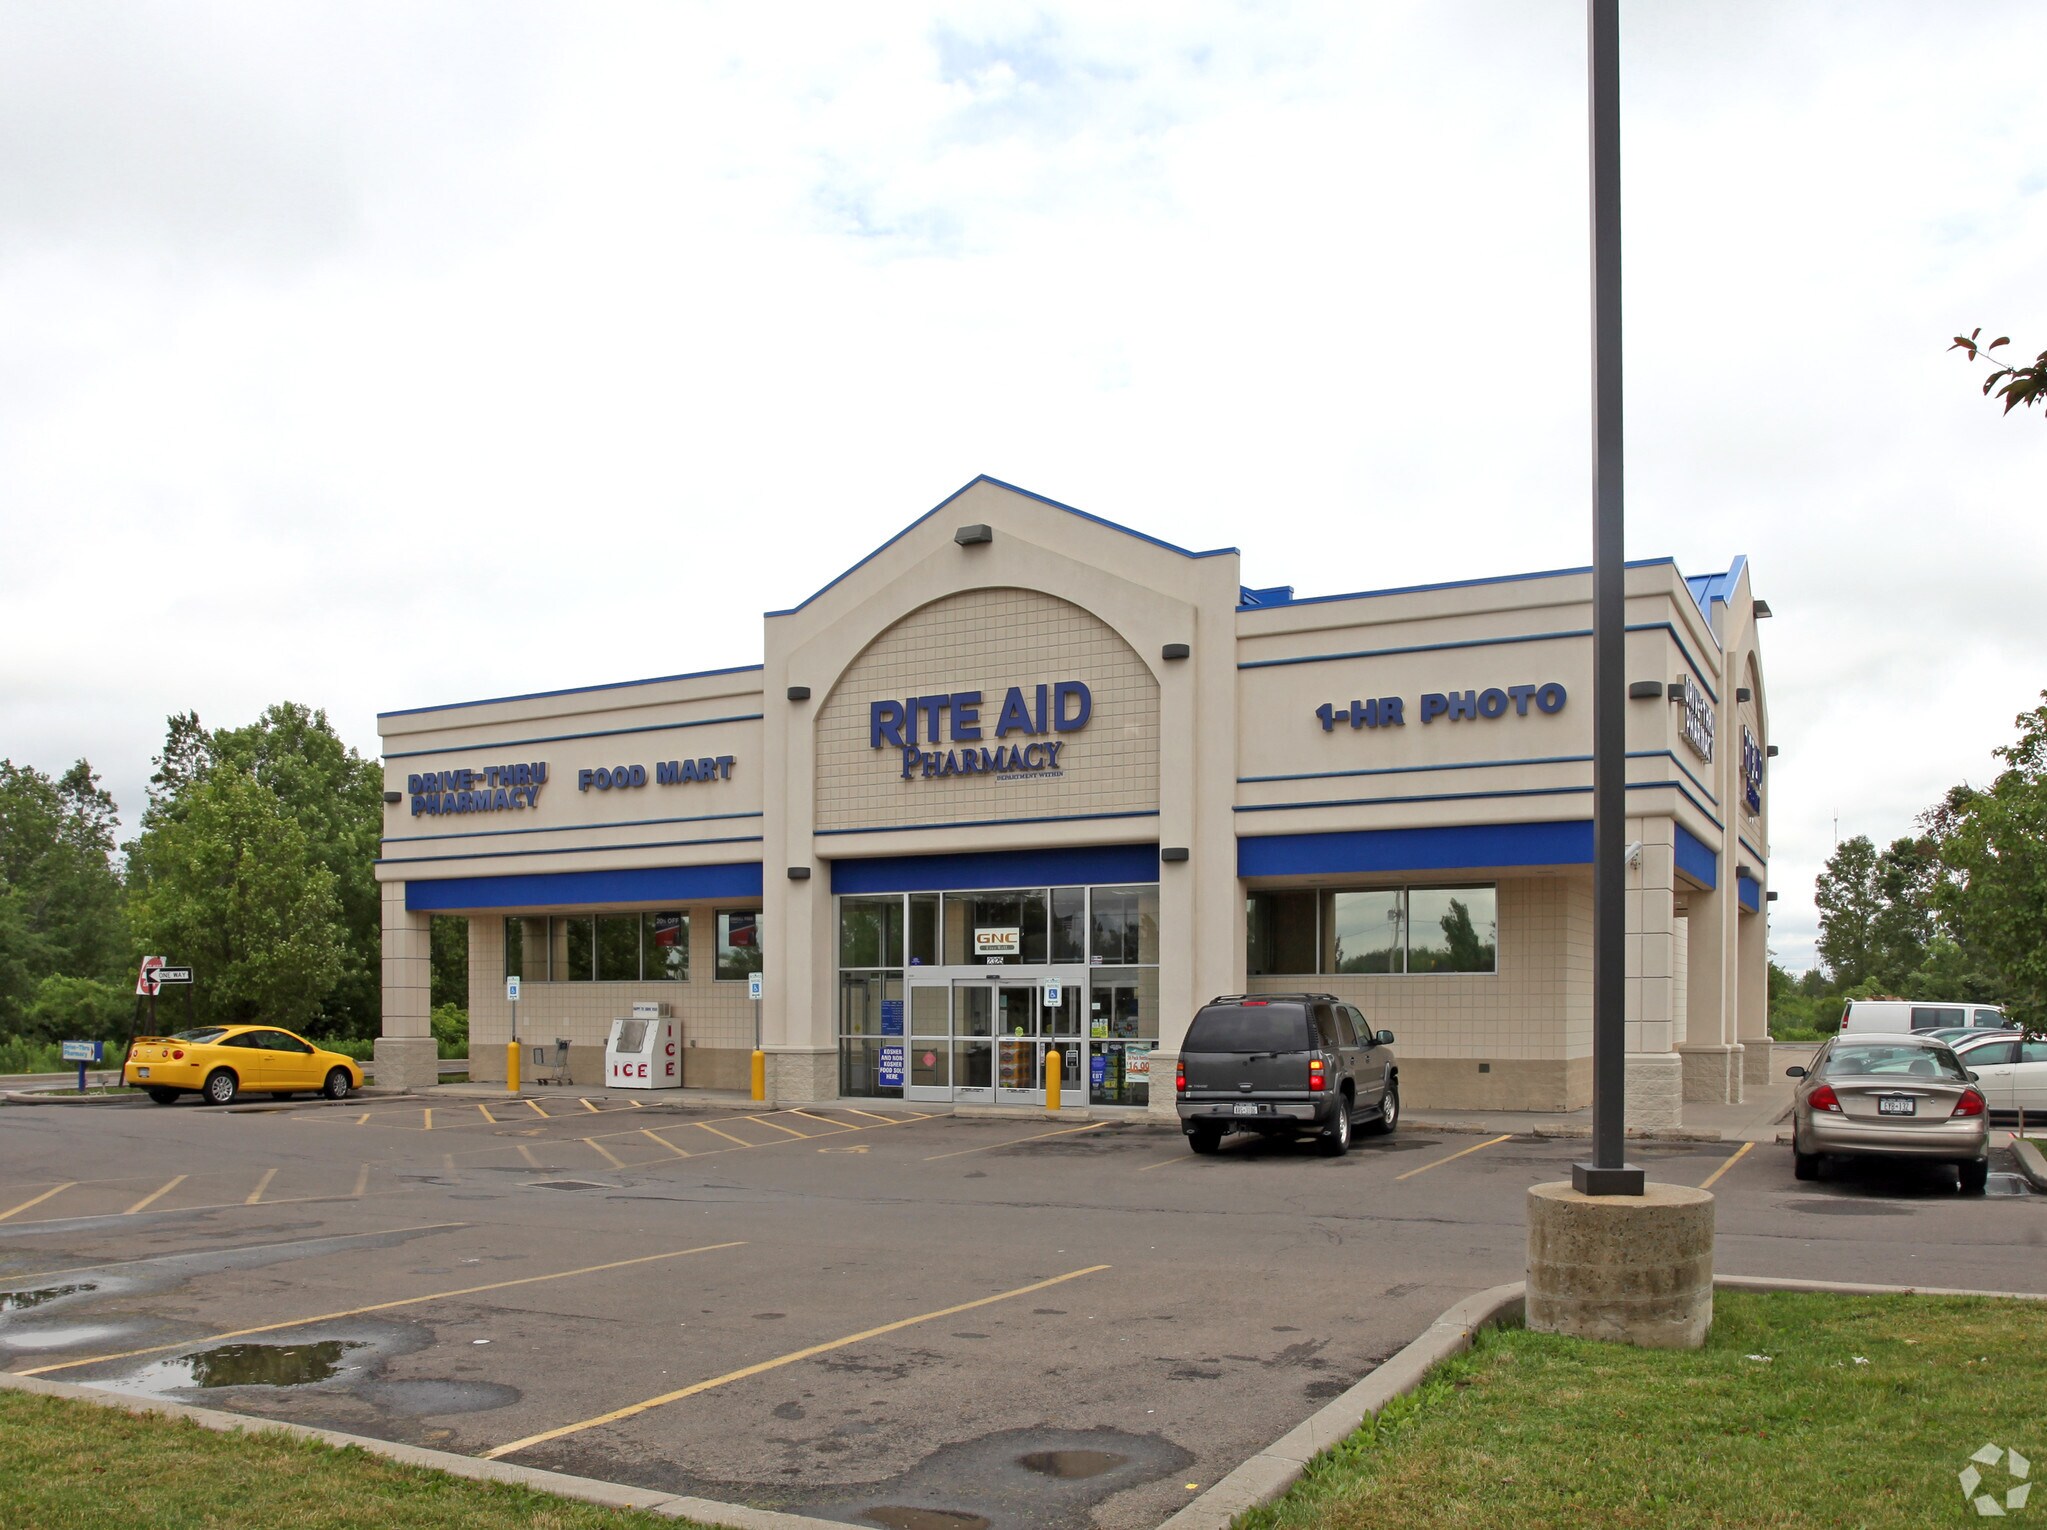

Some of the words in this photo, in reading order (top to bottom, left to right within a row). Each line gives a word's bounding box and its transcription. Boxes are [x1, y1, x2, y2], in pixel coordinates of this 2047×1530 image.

[870, 690, 983, 748] RITE
[995, 680, 1092, 737] AID
[1315, 696, 1405, 732] 1-HR
[1420, 682, 1568, 723] PHOTO
[407, 761, 549, 795] DRIVE-THRU
[578, 764, 647, 792] FOOD
[656, 755, 736, 785] MART
[900, 741, 1064, 780] PHARMACY
[997, 773, 1037, 781] DEPARTMENT
[410, 785, 541, 817] PHARMACY
[976, 933, 1018, 944] GNC
[664, 1025, 675, 1076] ICE
[613, 1063, 648, 1078] ICE
